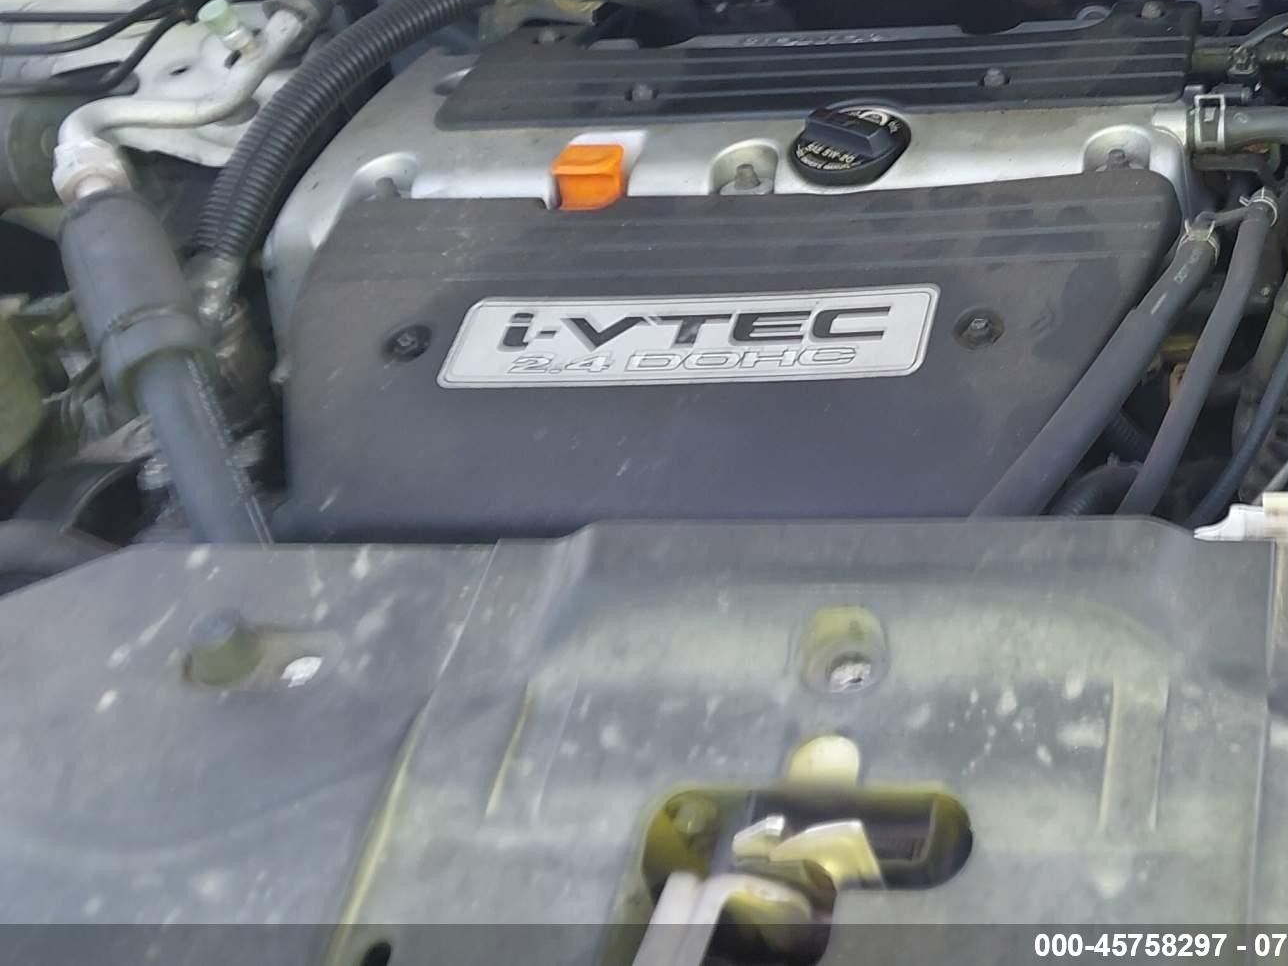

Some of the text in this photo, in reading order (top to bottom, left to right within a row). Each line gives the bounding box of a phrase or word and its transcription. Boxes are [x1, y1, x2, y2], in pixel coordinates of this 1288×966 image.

[501, 305, 892, 350] i-VTEC
[509, 345, 857, 375] 2.4 DOHC
